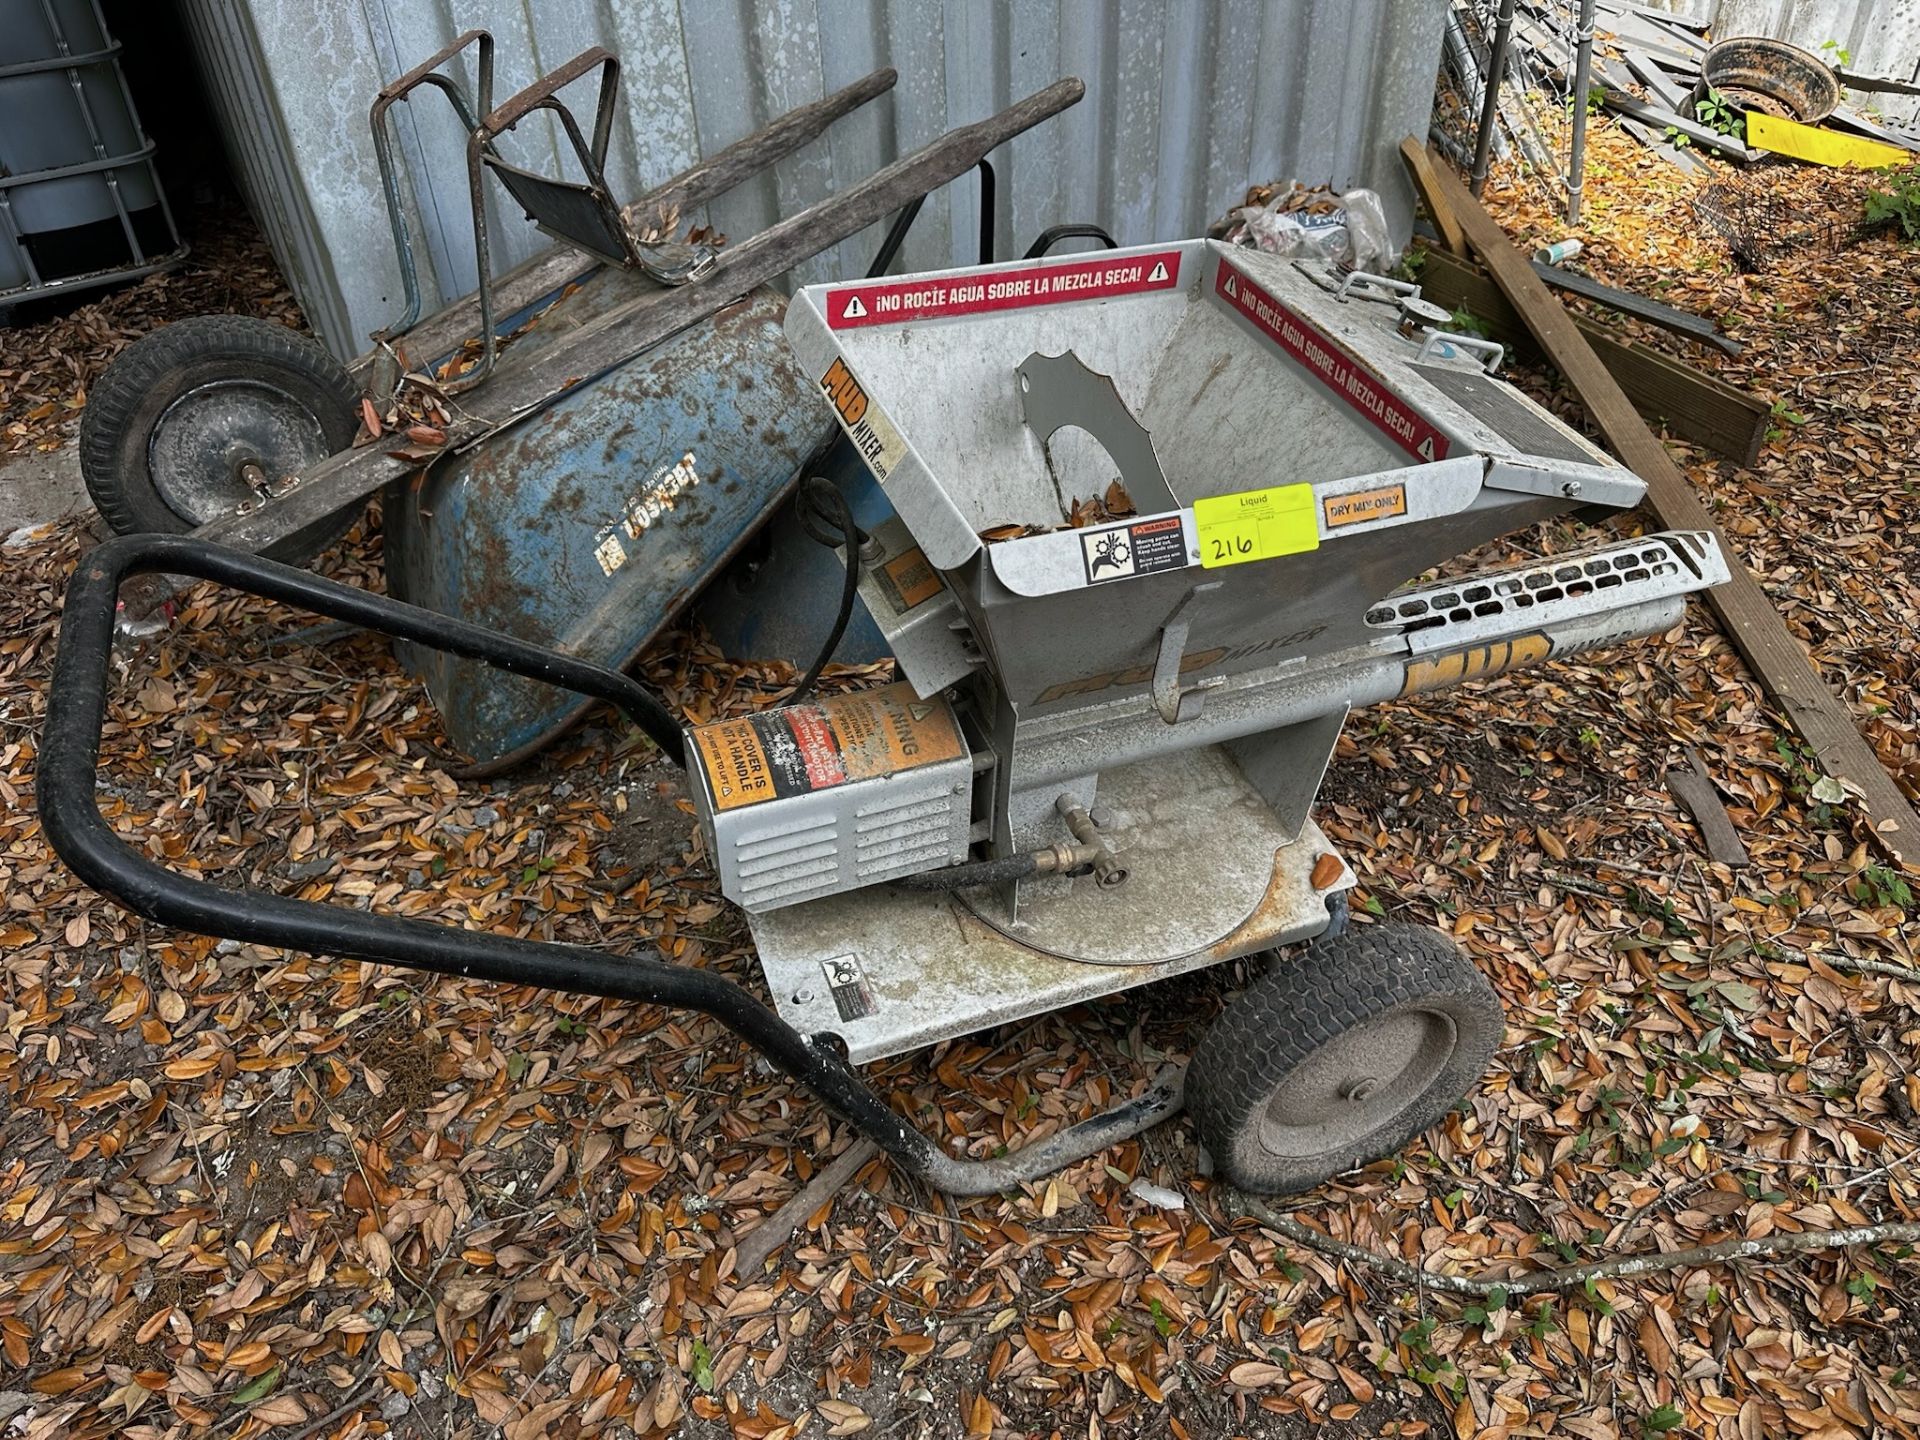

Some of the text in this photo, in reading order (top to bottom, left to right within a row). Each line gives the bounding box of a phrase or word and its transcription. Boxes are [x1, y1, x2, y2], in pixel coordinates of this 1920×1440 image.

[876, 266, 1142, 313] ¡NO ROCÍE AGUA SOBRE LA MEZCLA SECA!
[1241, 287, 1415, 443] ¡NO ROCÍE AGUA SOBRE LA MEZCLA SECA!
[819, 355, 870, 428] MUD
[1240, 494, 1268, 507] Liquid
[1330, 503, 1351, 518] DRY
[1375, 494, 1400, 508] ONLY
[1144, 520, 1176, 531] WARNING
[1212, 536, 1253, 560] 216
[880, 692, 920, 756] NING
[713, 748, 722, 761] USE
[716, 761, 725, 770] TO
[741, 736, 762, 773] COVER
[754, 775, 767, 789] IS
[719, 769, 730, 786] LIFT
[730, 746, 753, 792] HANDLE
